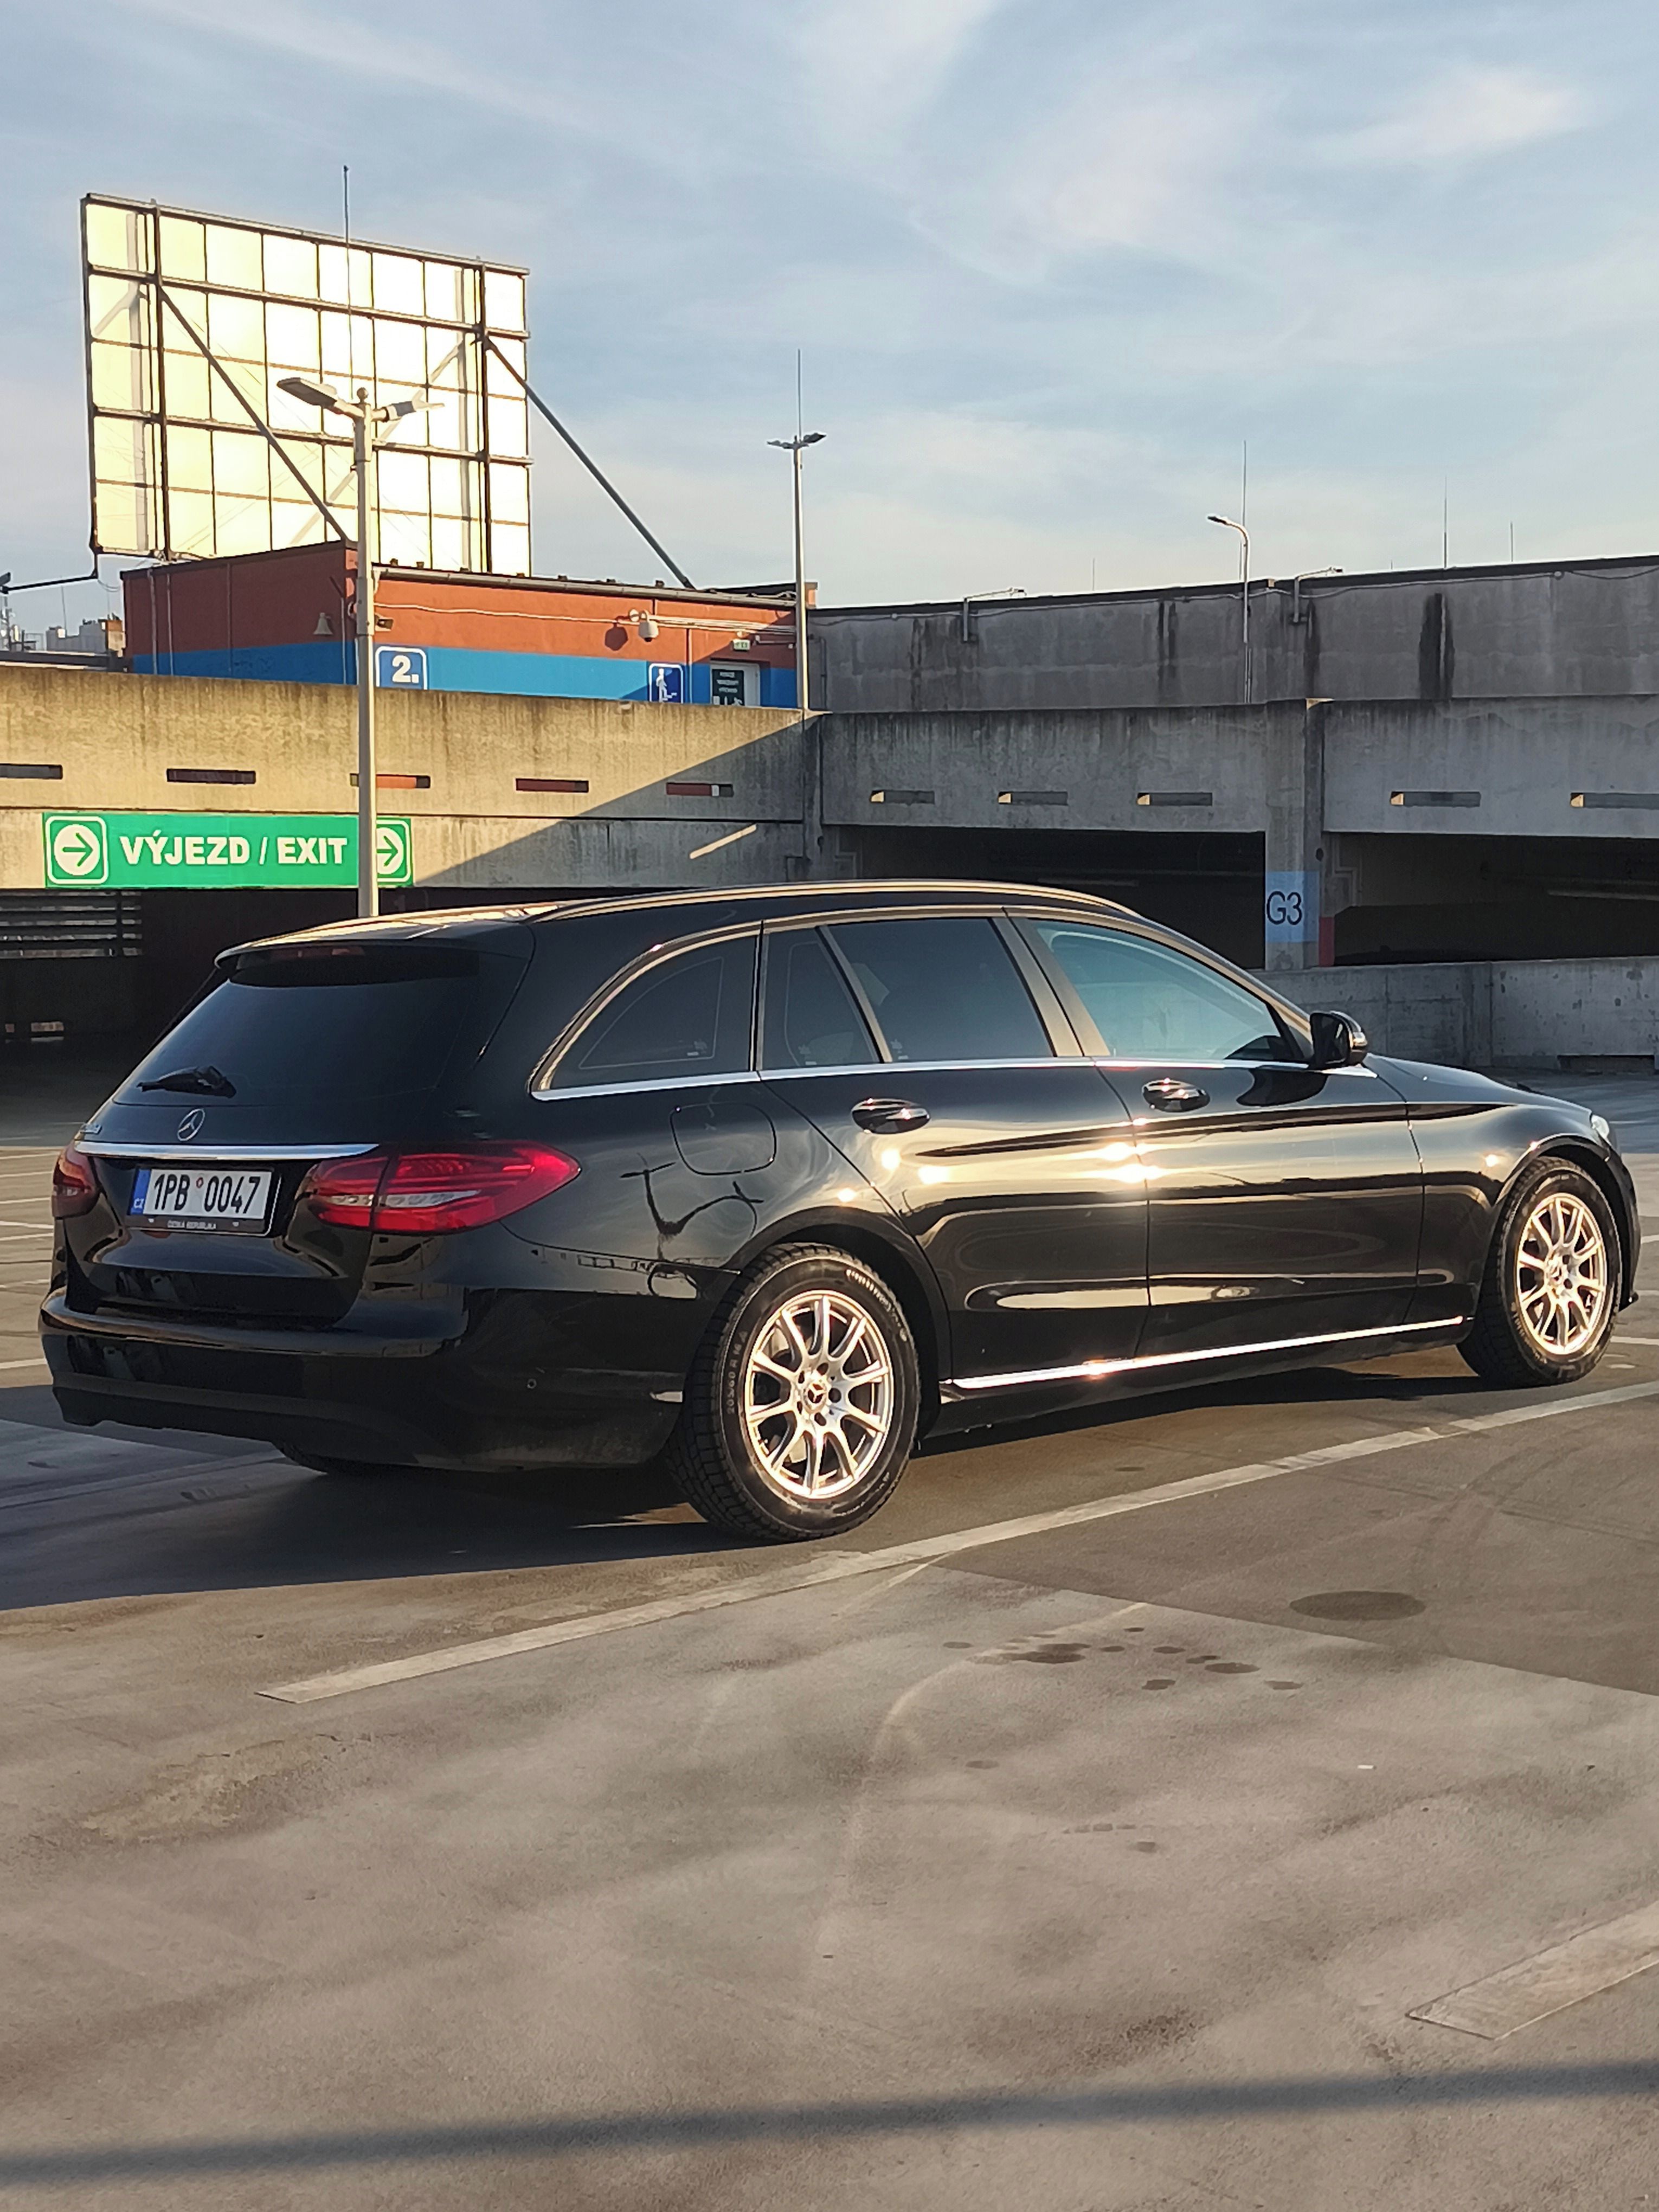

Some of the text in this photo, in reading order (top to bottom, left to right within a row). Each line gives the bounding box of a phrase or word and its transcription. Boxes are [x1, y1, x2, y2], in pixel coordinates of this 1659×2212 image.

[392, 655, 419, 683] 2.
[120, 830, 348, 865] VÝJEZD / EXIT
[1266, 891, 1302, 925] G3
[154, 1173, 261, 1214] 1PB 0047
